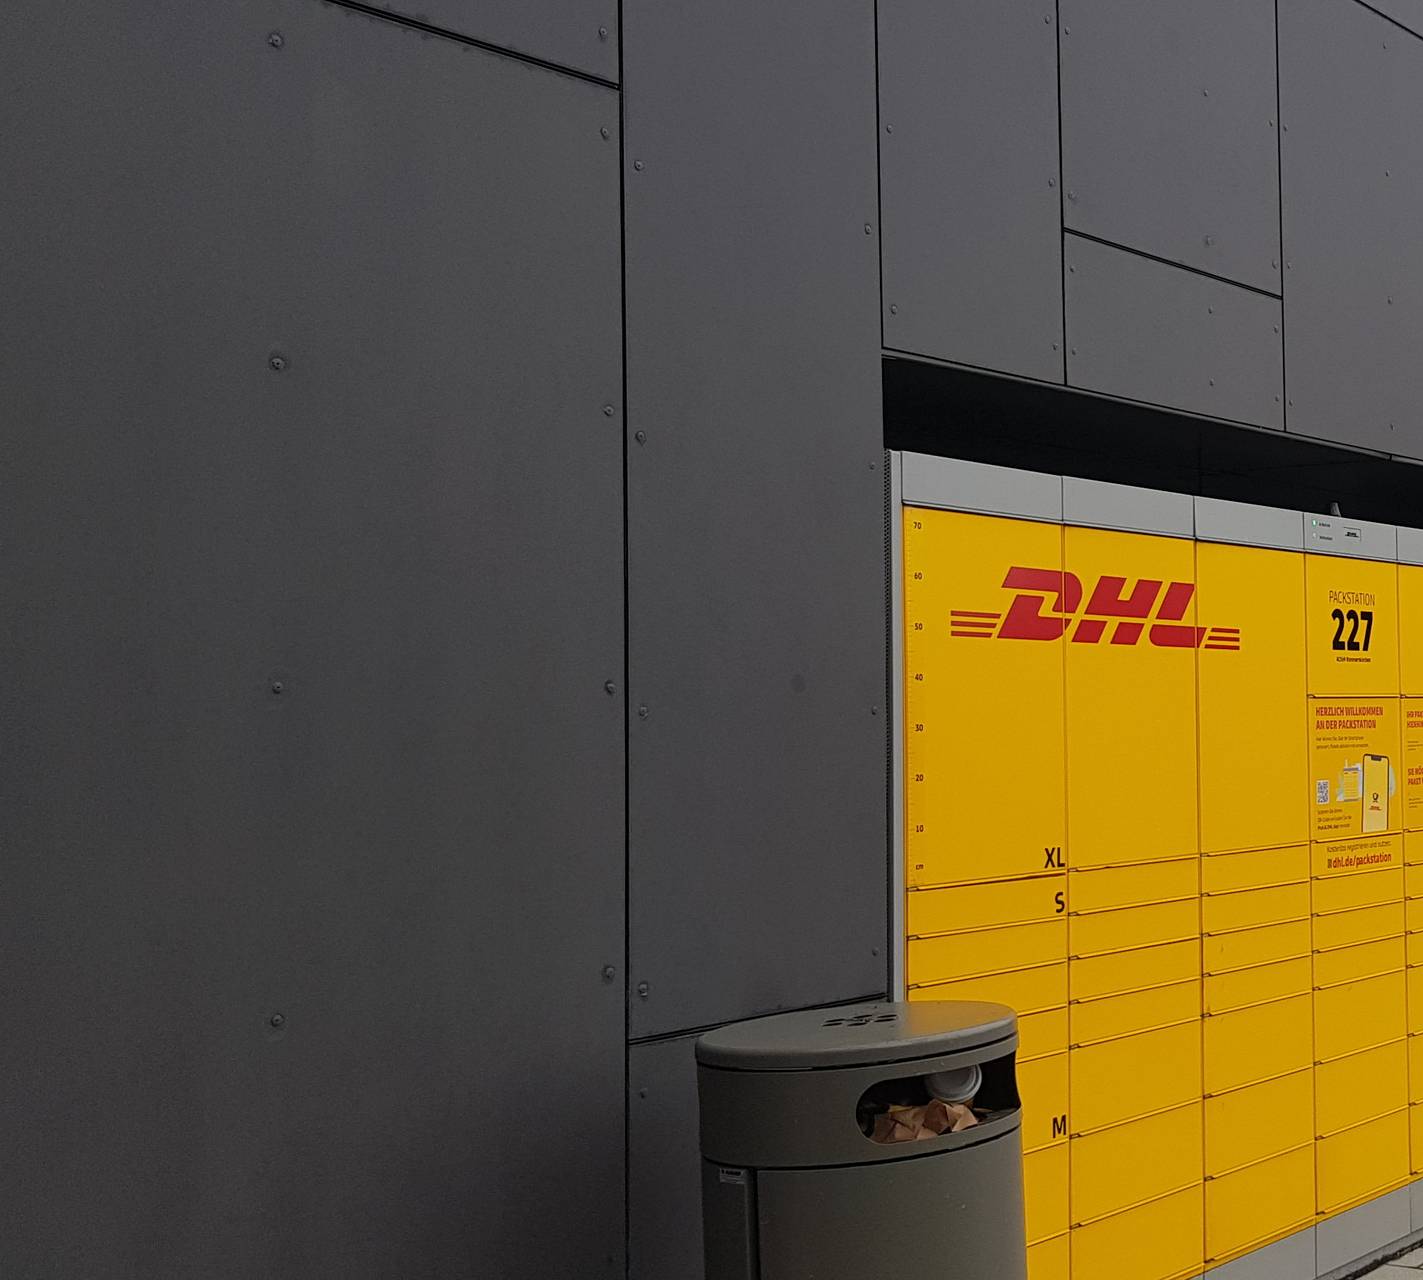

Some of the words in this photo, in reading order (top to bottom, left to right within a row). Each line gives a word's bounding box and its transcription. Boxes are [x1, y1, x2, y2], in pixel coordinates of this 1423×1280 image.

[913, 522, 922, 530] 70
[914, 572, 923, 580] 60
[1329, 590, 1376, 606] PACKSTATION
[997, 566, 1207, 648] DHL
[914, 622, 923, 631] 50
[1331, 608, 1373, 651] 227
[914, 674, 923, 682] 40
[1315, 706, 1344, 717] HERZLICH
[1345, 706, 1384, 716] WILLKOMMEN
[915, 724, 924, 732] 30
[1315, 720, 1325, 730] AN
[1326, 720, 1338, 730] DER
[1338, 719, 1377, 729] PACKSTATION
[915, 774, 924, 782] 20
[915, 825, 924, 833] 10
[1044, 847, 1065, 868] XL
[1332, 852, 1392, 869] dhl.de/packstation
[1055, 892, 1065, 913] S
[1053, 1114, 1066, 1138] M
